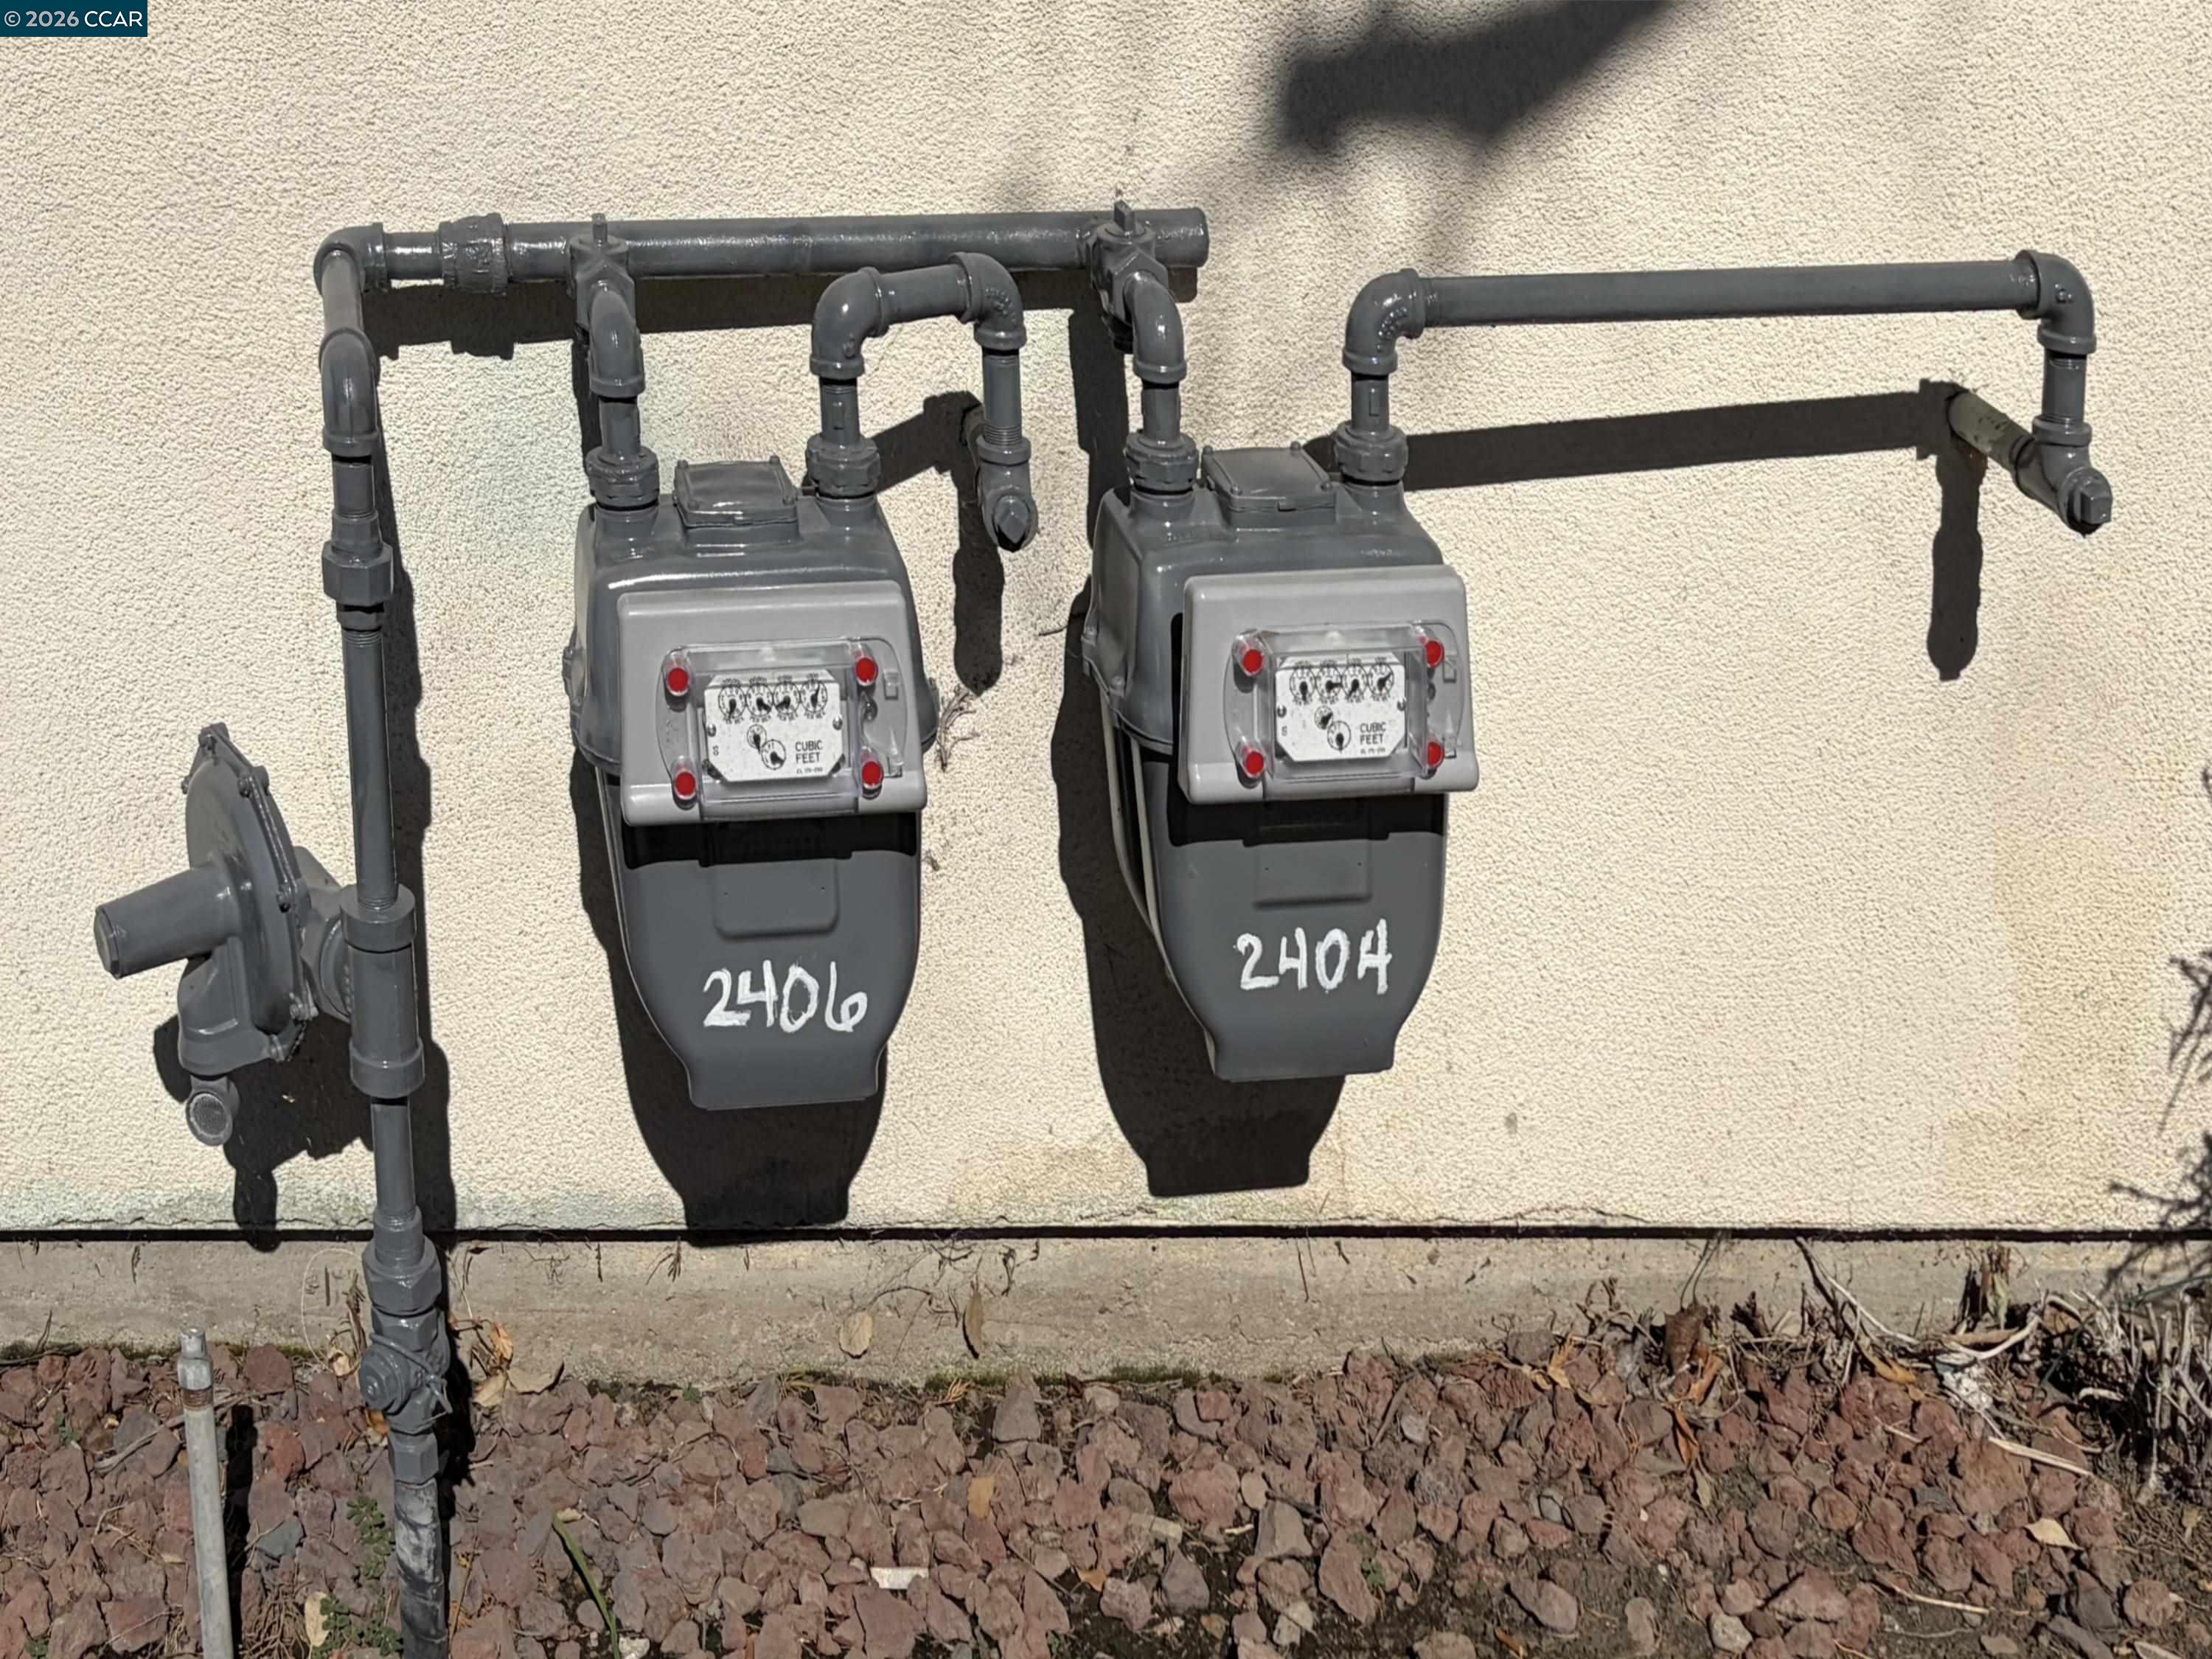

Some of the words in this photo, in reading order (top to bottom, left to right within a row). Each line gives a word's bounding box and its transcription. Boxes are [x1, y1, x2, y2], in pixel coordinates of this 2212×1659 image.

[1359, 721, 1387, 733] CUBIC
[1360, 734, 1383, 745] FEET
[796, 740, 823, 752] CUBIC
[796, 752, 820, 764] FEET
[1234, 919, 1392, 995] 2404
[703, 959, 868, 1033] 2406
